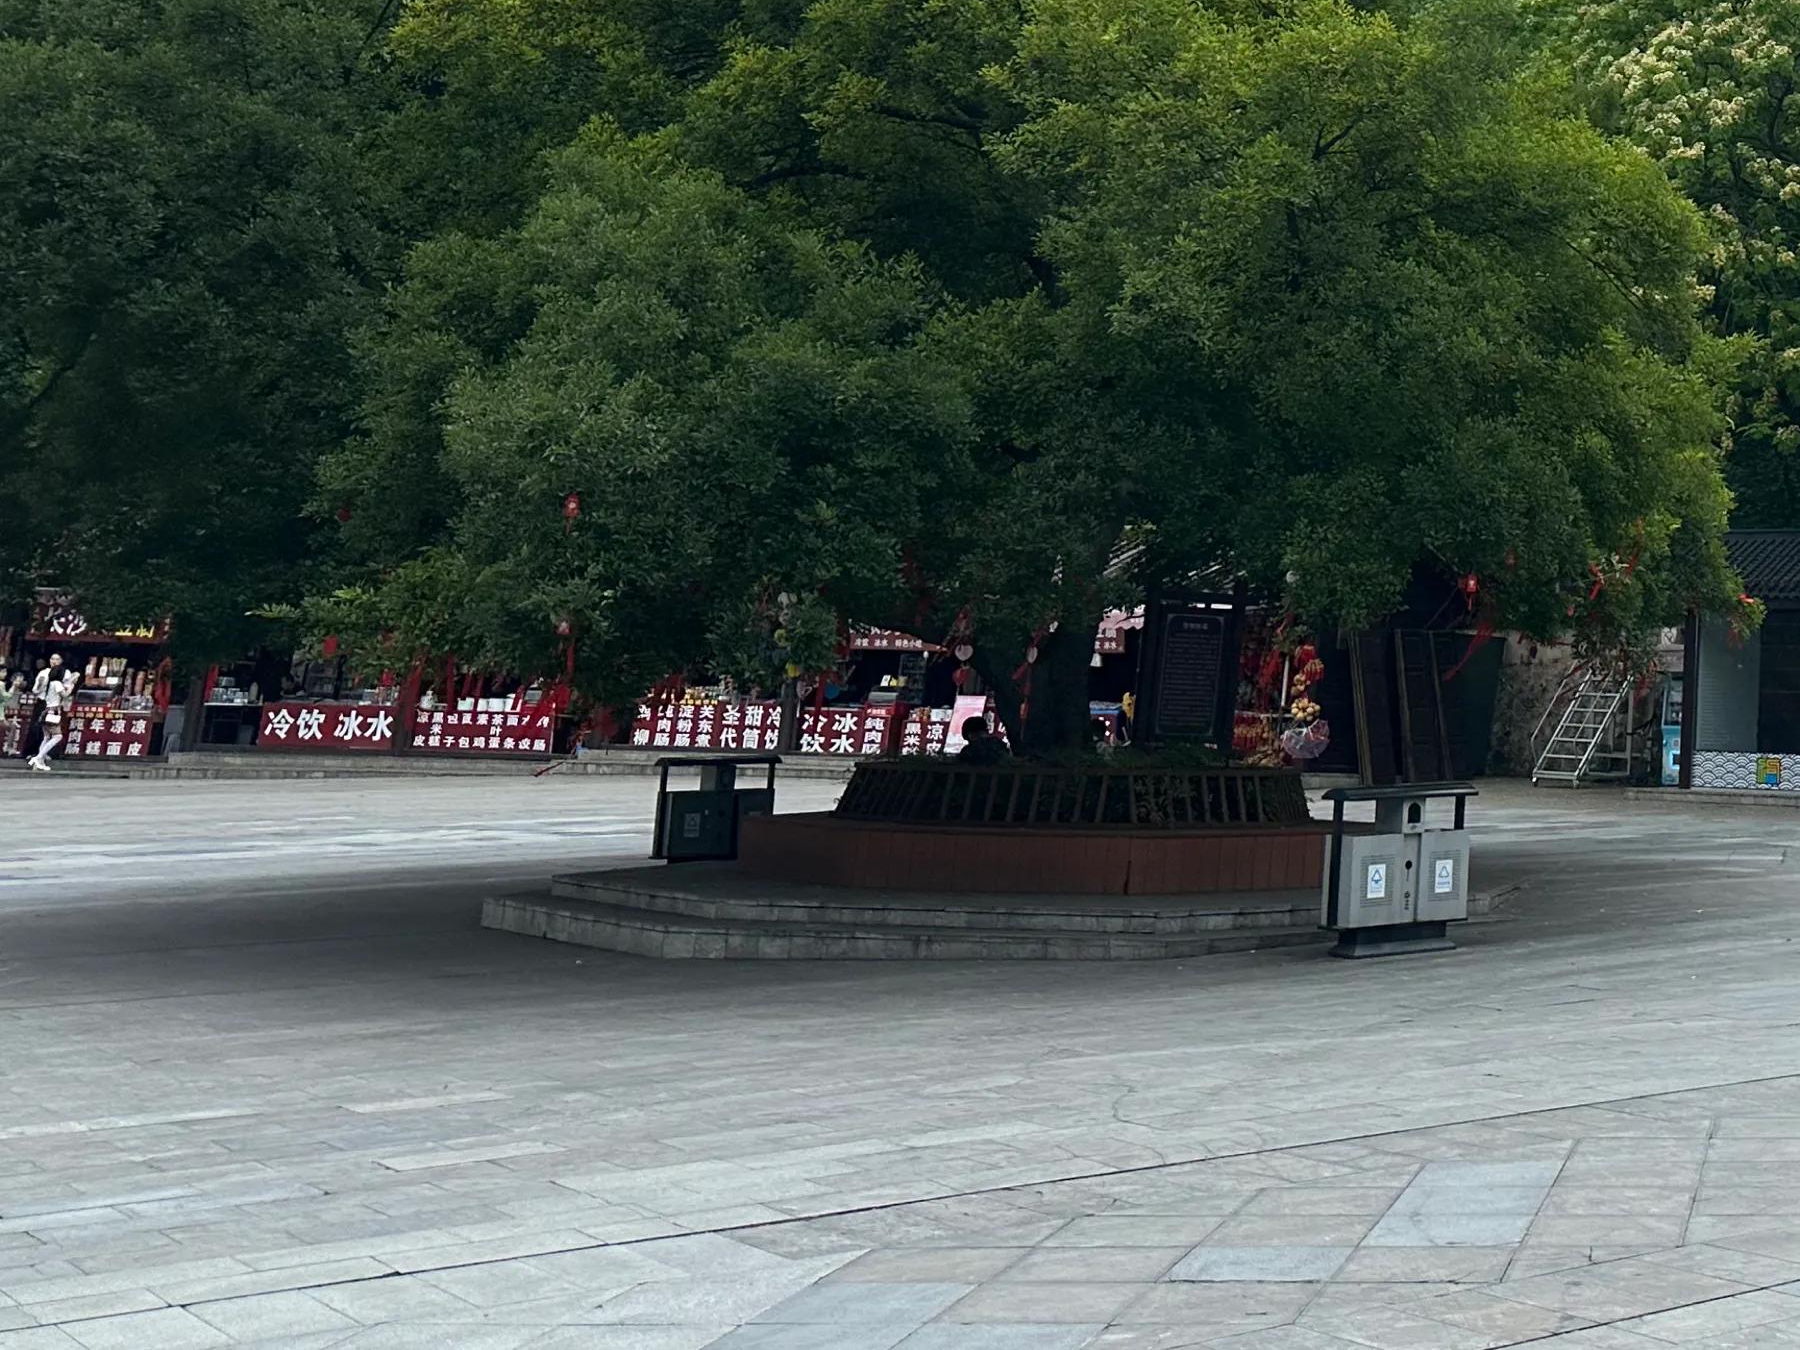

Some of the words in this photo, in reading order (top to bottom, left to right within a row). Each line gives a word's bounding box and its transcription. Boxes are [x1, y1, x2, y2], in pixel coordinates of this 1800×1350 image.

[85, 718, 105, 756] 年糕
[106, 719, 126, 756] 凉面
[126, 718, 147, 756] 凉皮
[264, 708, 326, 740] 冷饮
[334, 709, 394, 741] 冰水
[443, 713, 459, 747] 包子
[488, 714, 504, 749] 茶叶蛋
[674, 705, 695, 747] 淀粉肠
[695, 705, 715, 748] 关东煮
[720, 705, 741, 749] 圣代
[742, 705, 765, 750] 甜筒
[830, 712, 858, 754] 冰水
[862, 717, 885, 754] 纯肉肠
